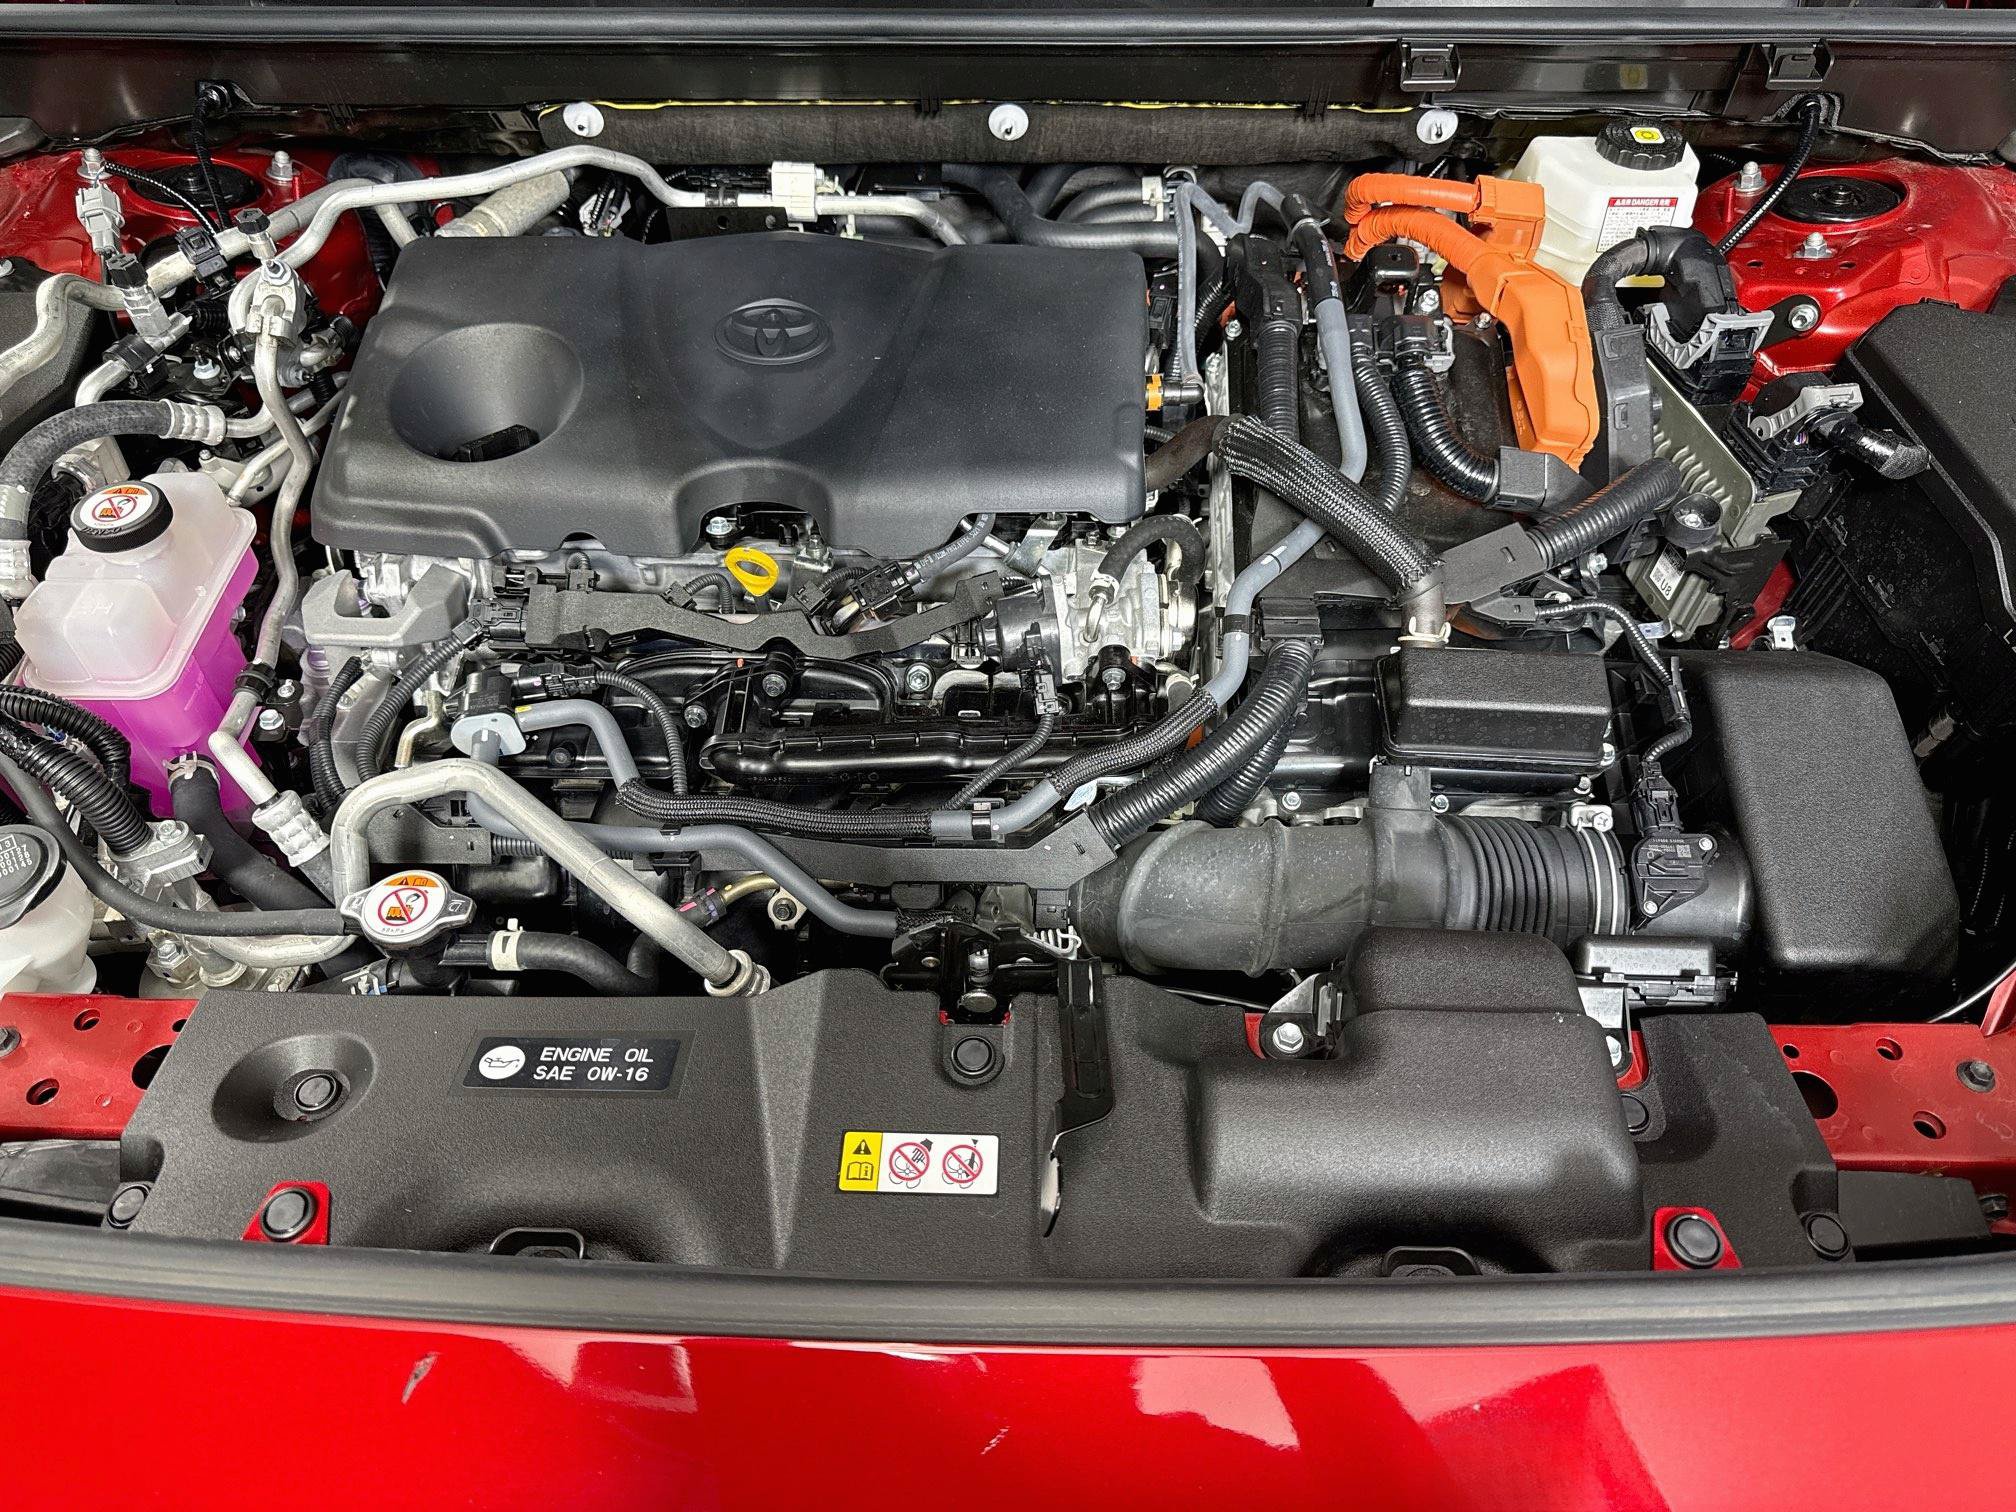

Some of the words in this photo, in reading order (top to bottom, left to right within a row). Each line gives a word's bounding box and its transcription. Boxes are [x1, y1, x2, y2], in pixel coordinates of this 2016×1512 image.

[1660, 578, 1672, 596] U8
[0, 840, 11, 851] 3
[540, 1047, 613, 1062] ENGINE
[624, 1048, 654, 1063] OIL
[533, 1065, 576, 1081] SAE
[587, 1066, 649, 1082] 0W-16
